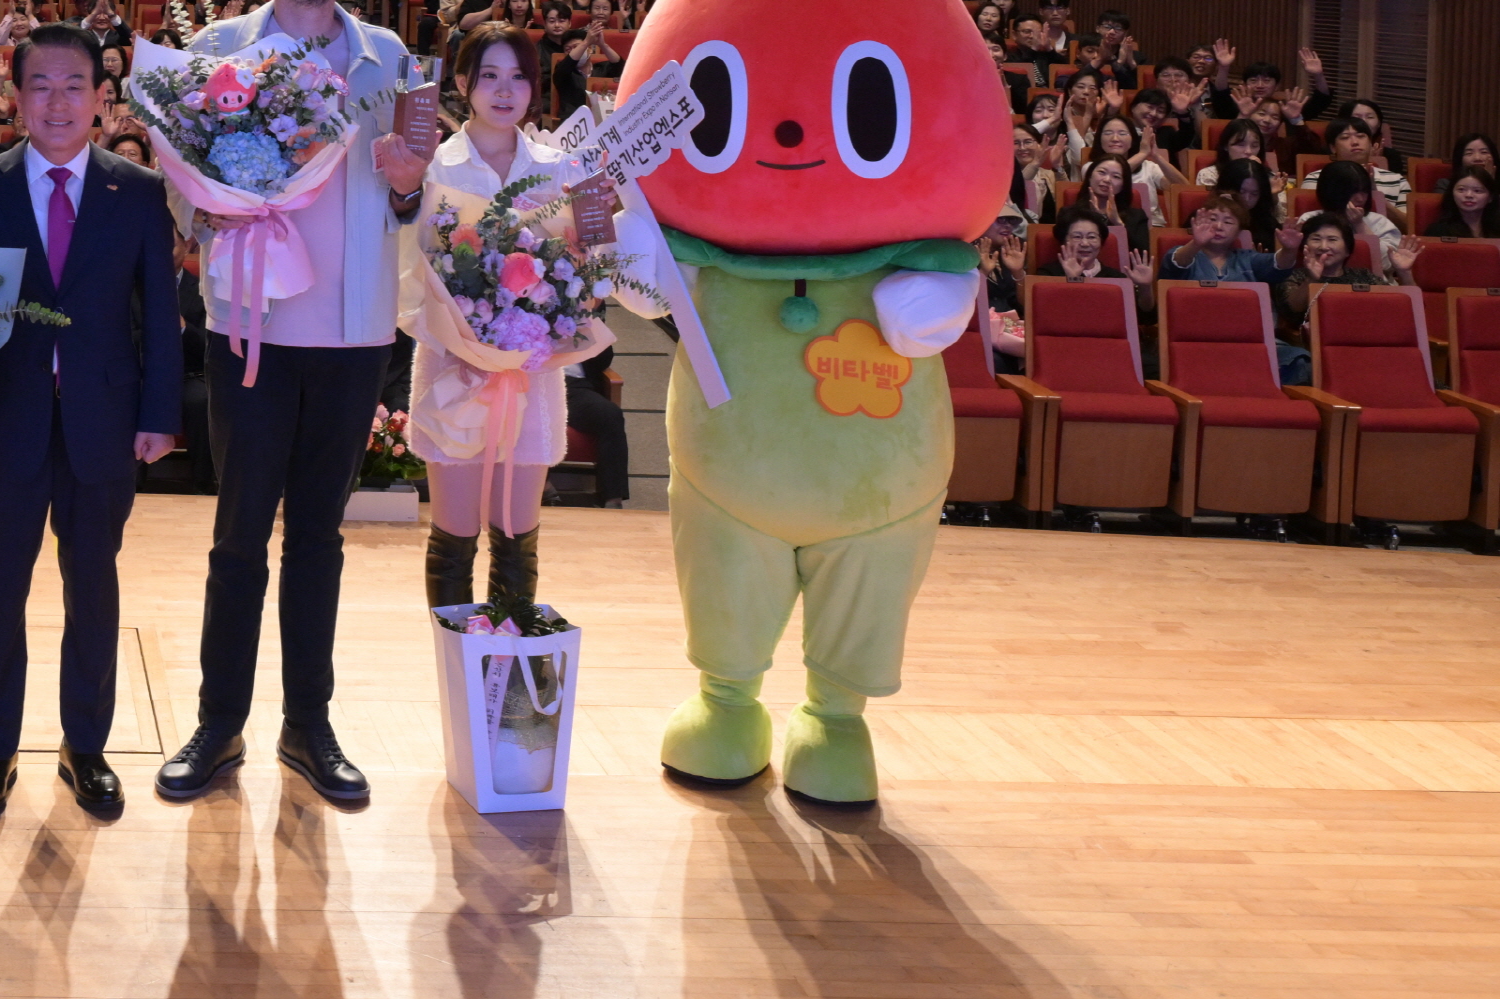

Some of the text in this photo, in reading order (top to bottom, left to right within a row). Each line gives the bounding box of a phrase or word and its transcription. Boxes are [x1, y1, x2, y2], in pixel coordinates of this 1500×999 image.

[618, 72, 676, 126] International Strawberry
[642, 105, 656, 119] Expo
[659, 83, 680, 104] Nonsan
[560, 117, 590, 154] 2027
[606, 95, 695, 186] 딸기산업엑스포
[817, 357, 899, 390] 비타벨
